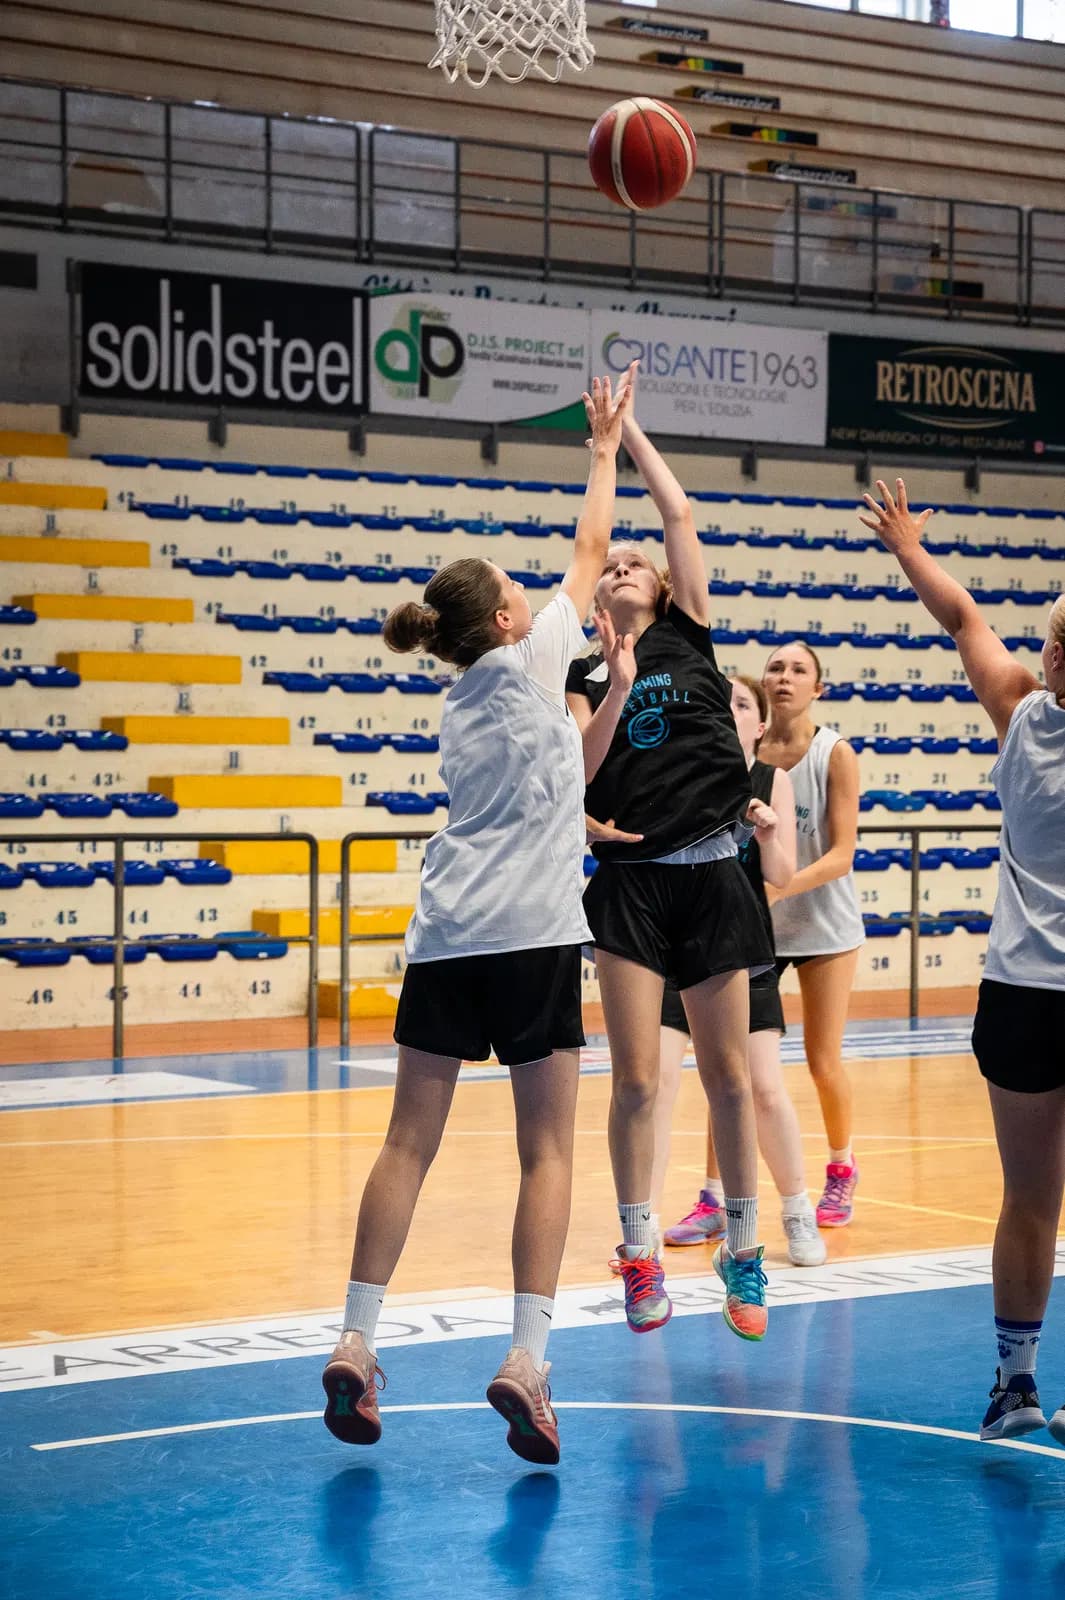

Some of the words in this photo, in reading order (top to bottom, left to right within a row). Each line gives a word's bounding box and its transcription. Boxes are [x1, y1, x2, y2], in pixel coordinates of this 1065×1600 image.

[86, 279, 362, 404] solidsteel
[467, 333, 499, 349] D.I.S.
[505, 337, 565, 356] PROJECT
[568, 345, 585, 358] srl
[713, 385, 786, 403] TECNOLOGIE
[876, 360, 1036, 412] RETROSCENA
[673, 399, 696, 413] PER
[831, 428, 857, 440] NEW
[860, 430, 920, 445] DIMENSION
[922, 433, 938, 445] OF
[940, 434, 960, 446] FISH
[963, 436, 1024, 450] RESTAURANT
[160, 545, 177, 556] 42
[217, 547, 232, 558] 41
[272, 549, 288, 560] 40
[325, 551, 342, 562] 39
[204, 602, 223, 615] 42
[262, 604, 277, 617] 41
[319, 606, 335, 618] 40
[2, 648, 22, 660] 43
[249, 655, 267, 667] 42
[308, 656, 324, 668] 41
[365, 657, 382, 668] 40
[860, 668, 877, 679] 30
[46, 714, 66, 727] 43
[298, 716, 316, 729] 42
[357, 718, 371, 729] 41
[412, 719, 429, 730] 40
[874, 722, 887, 733] 31
[920, 723, 935, 734] 30
[26, 774, 47, 787] 44
[93, 773, 113, 786] 43
[349, 773, 368, 785] 42
[409, 773, 425, 785] 41
[885, 774, 900, 784] 32
[932, 773, 947, 784] 31
[862, 891, 878, 902] 35
[965, 888, 981, 898] 33
[56, 910, 77, 925] 45
[129, 910, 148, 924] 44
[196, 908, 218, 922] 43
[925, 955, 942, 967] 35
[32, 989, 53, 1004] 46
[180, 983, 201, 998] 44
[249, 980, 271, 995] 43
